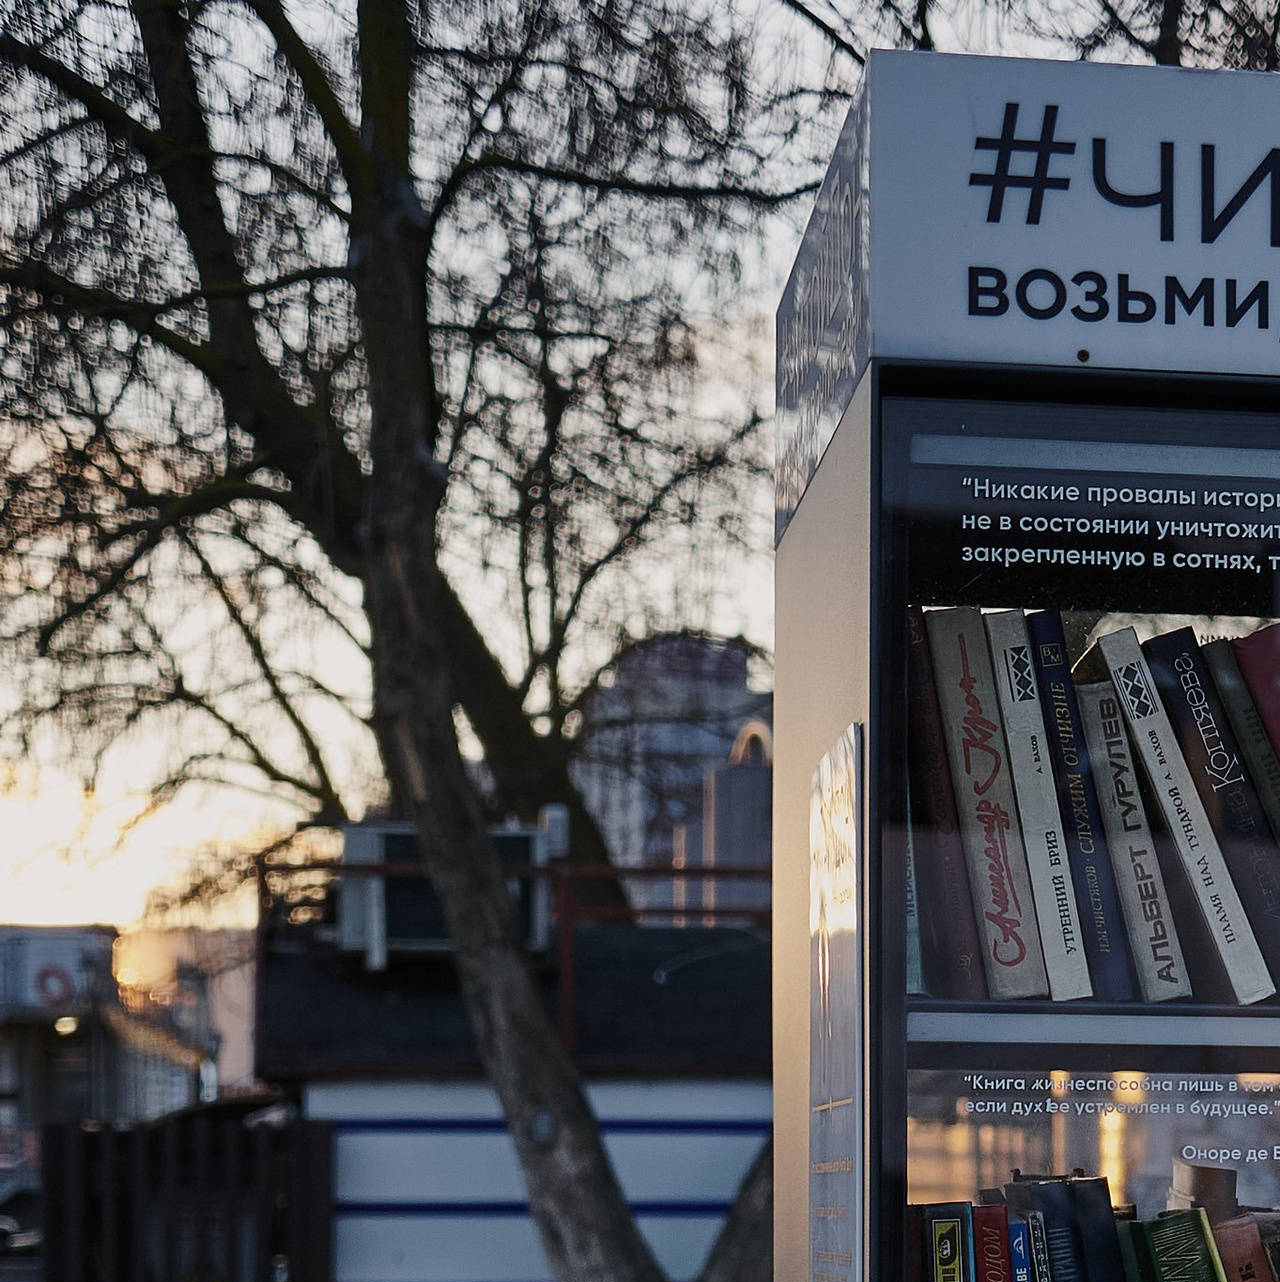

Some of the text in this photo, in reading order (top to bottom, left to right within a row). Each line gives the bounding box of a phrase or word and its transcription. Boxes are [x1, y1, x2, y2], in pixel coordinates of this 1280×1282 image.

[1087, 486, 1196, 508] провалы
[961, 514, 992, 530] не
[1019, 516, 1149, 535] состоянии
[961, 546, 1146, 570] закрепленную
[1172, 552, 1262, 574] сотнях,
[1050, 681, 1095, 855] СЛУЖИМ ОТЧИЗНЕ
[1099, 697, 1179, 985] АЛЬБЕРТ ГУРУЛЕВ
[1148, 729, 1236, 944] ПЛАМЯ НАД ТУНДРОЙ ВАХОВ
[1045, 830, 1077, 956] УТРЕННИЙ БРИЗ
[1177, 1079, 1224, 1092] лишь
[964, 1102, 1170, 1118] если дух устремлен
[1182, 1145, 1241, 1163] Оноре
[1245, 1147, 1268, 1162] де
